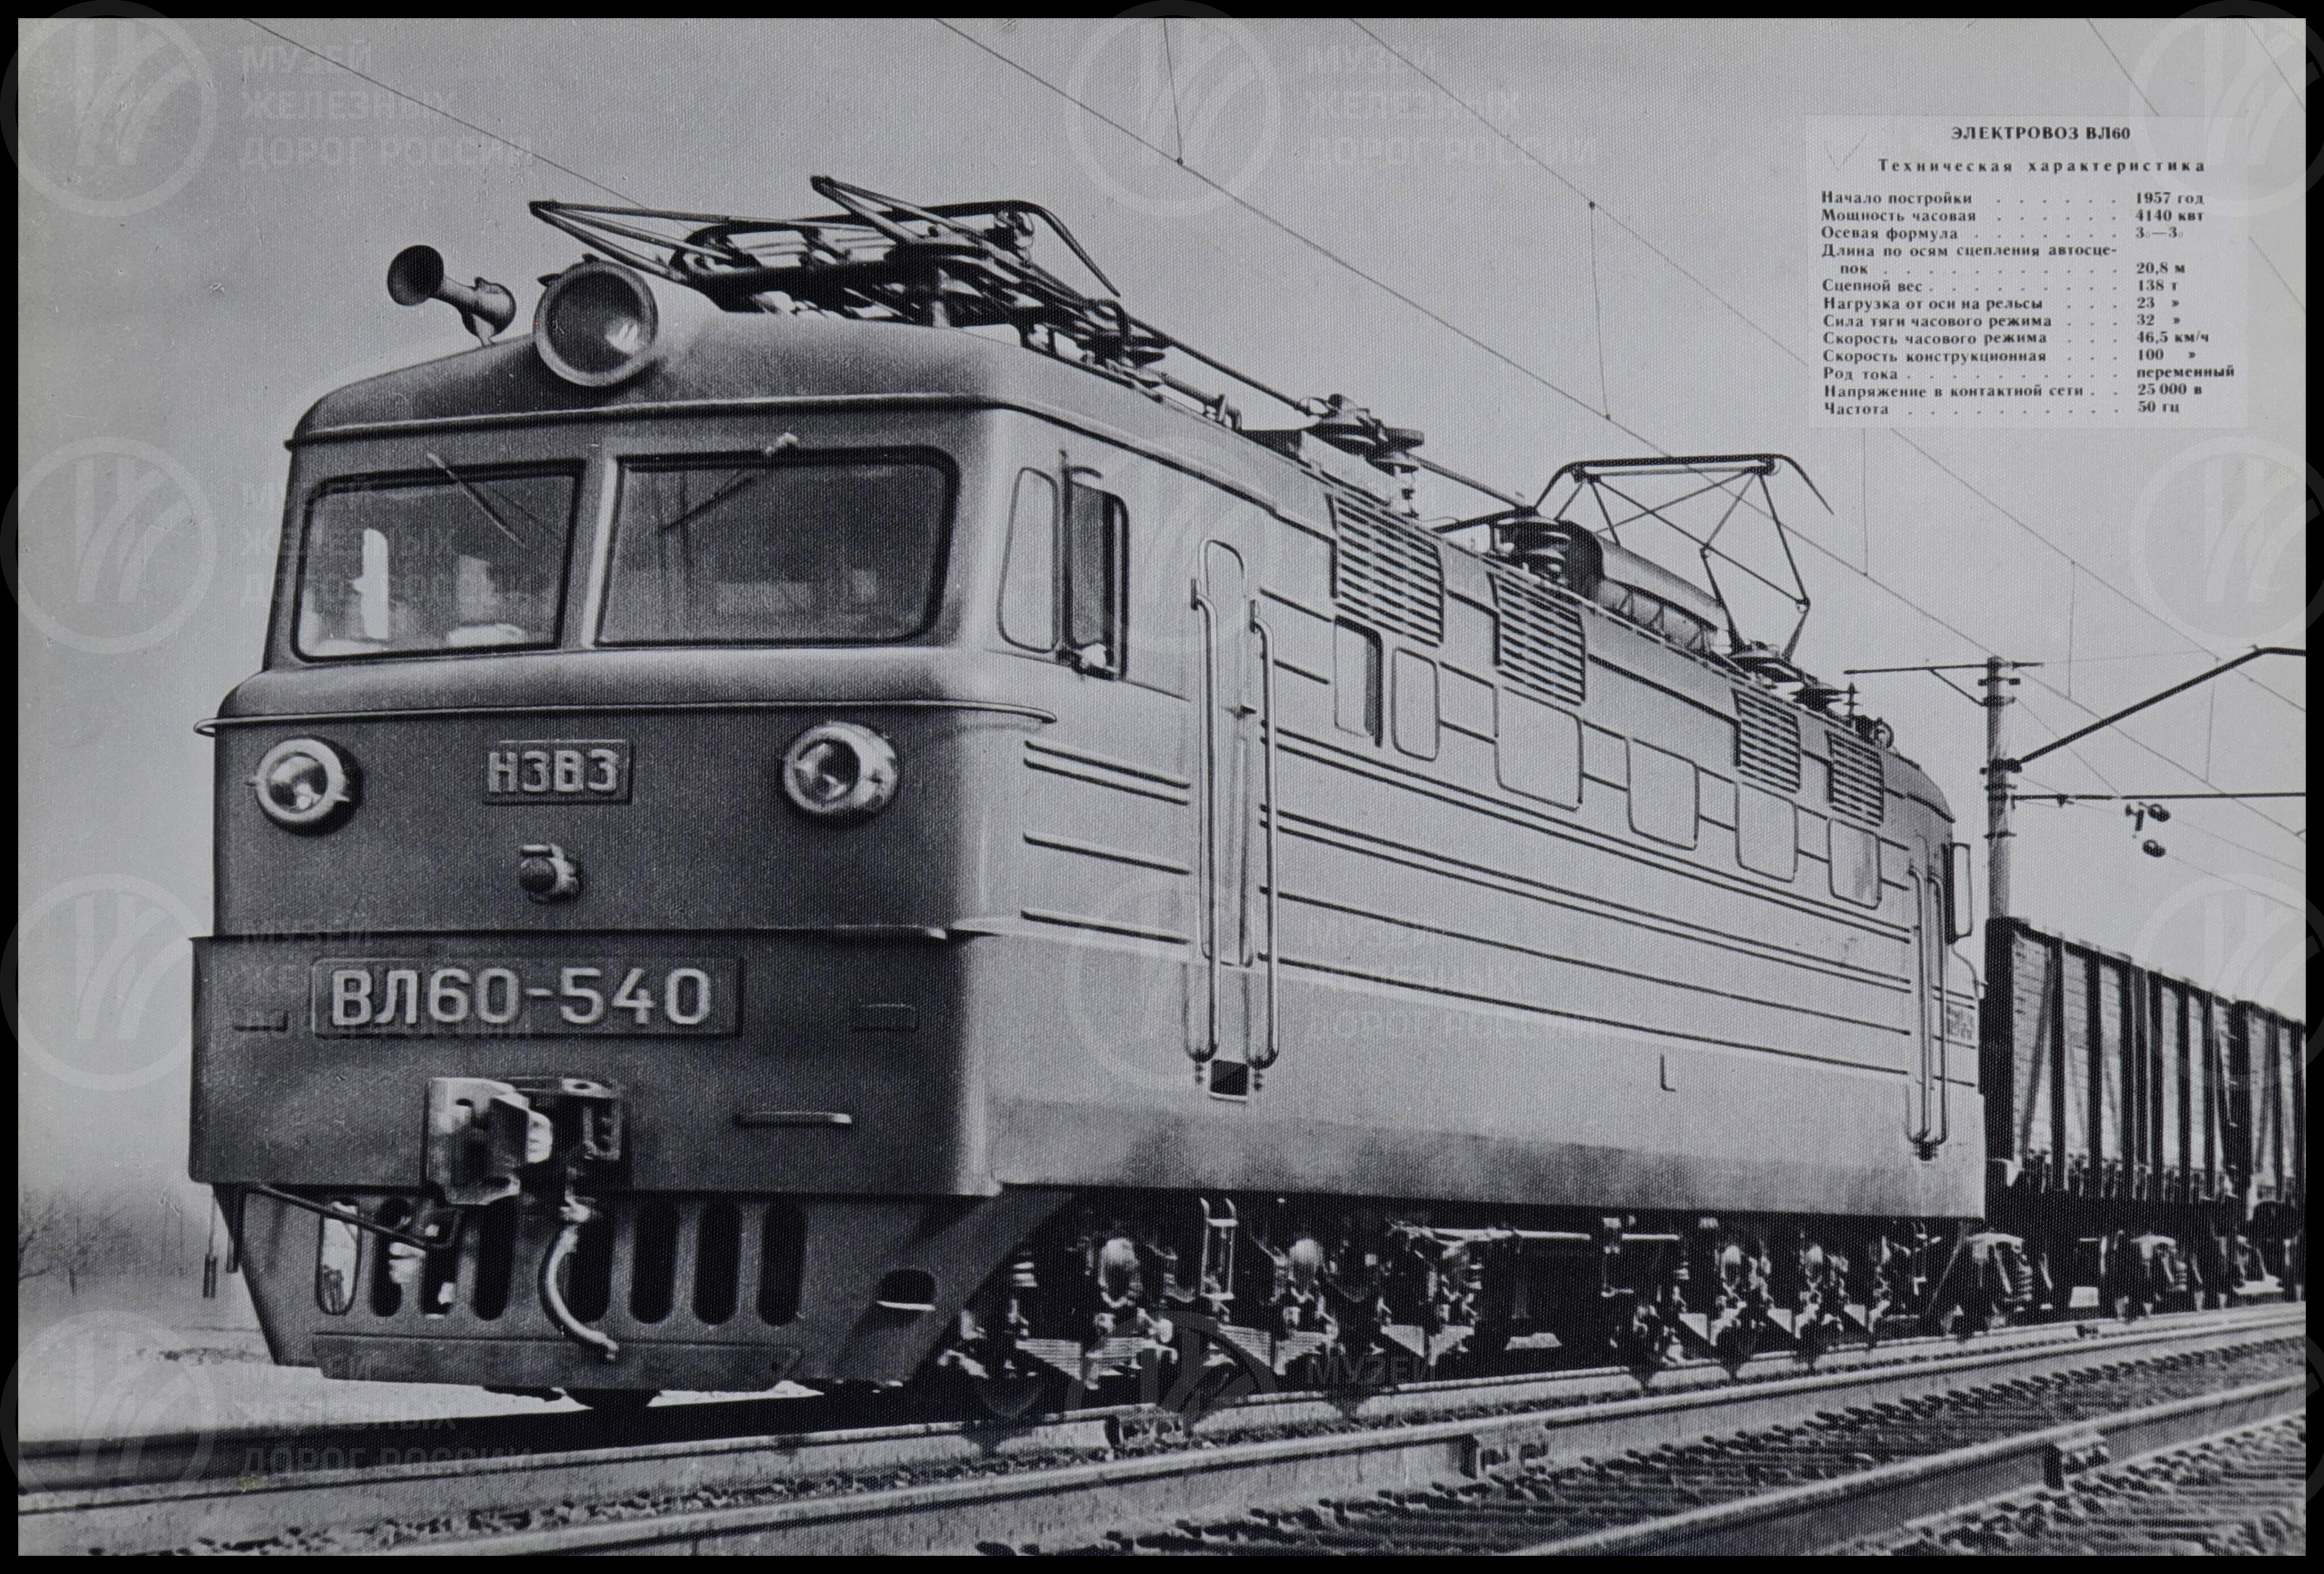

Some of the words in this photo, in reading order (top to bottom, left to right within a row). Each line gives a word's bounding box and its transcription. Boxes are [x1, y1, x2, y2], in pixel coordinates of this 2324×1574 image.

[1951, 126, 2080, 140] ЭЛЕКТРОВОЗ
[2085, 126, 2132, 140] ВЛ60
[1877, 158, 2013, 172] Техническая
[2028, 161, 2205, 175] характеристика
[1821, 190, 1883, 204] Начало
[1887, 191, 1973, 207] постройки
[2136, 191, 2172, 205] 1957
[2176, 195, 2204, 205] год
[1821, 208, 1906, 222] Мощность
[1912, 212, 1977, 222] часовая
[2135, 209, 2173, 222] 4140
[2177, 212, 2205, 222] квт
[1820, 226, 1880, 239] Осевая
[1885, 227, 1959, 243] формула
[1821, 243, 1875, 258] Длина
[1882, 247, 1903, 257] по
[1909, 247, 1949, 257] осям
[1955, 246, 2040, 257] сцепления
[2047, 246, 2117, 257] автосце-
[1839, 264, 1868, 275] пок
[2136, 262, 2170, 275] 20,8
[2173, 264, 2186, 274] м
[1821, 278, 1892, 292] Сцепной
[1897, 283, 1923, 293] вес
[2138, 279, 2165, 292] 138
[1823, 296, 1901, 313] Нагрузка
[1905, 300, 1923, 310] от
[1927, 300, 1956, 310] оси
[1960, 300, 1981, 310] на
[1985, 299, 2044, 313] рельсы
[2136, 296, 2156, 309] 23
[1822, 314, 1864, 327] Сила
[1870, 318, 1906, 327] тяги
[1910, 317, 1984, 327] часового
[1988, 317, 2053, 330] режима
[2136, 313, 2155, 327] 32
[1822, 331, 1898, 347] Скорость
[1904, 335, 1977, 345] часового
[1983, 334, 2048, 347] режима
[2136, 330, 2170, 344] 46,5
[2174, 330, 2210, 343] км/ч
[1822, 349, 1898, 365] Скорость
[1905, 352, 2047, 365] конструкционная
[2138, 348, 2165, 361] 100
[1822, 366, 1854, 381] Род
[1862, 371, 1898, 380] тока
[2136, 364, 2235, 381] переменный
[1824, 384, 1927, 401] Напряжение
[1950, 384, 2043, 397] контактной
[2048, 387, 2084, 397] сети
[1824, 402, 1889, 415] Частота
[2137, 400, 2157, 413] 50
[2161, 403, 2180, 414] гц
[332, 967, 711, 1026] ВЛ60-540
